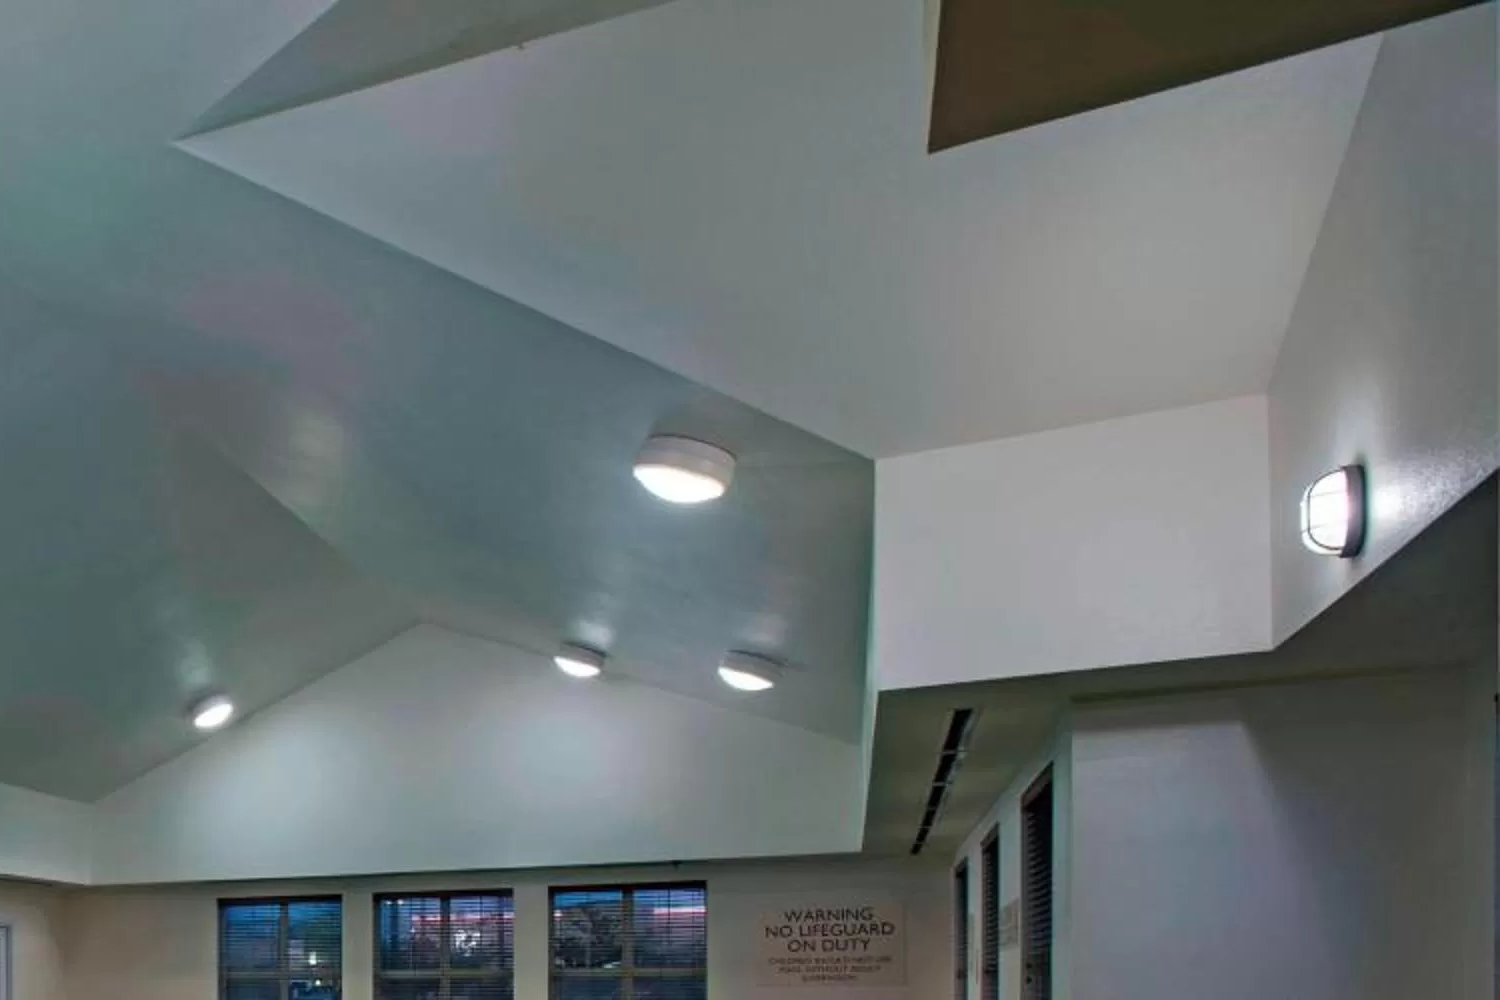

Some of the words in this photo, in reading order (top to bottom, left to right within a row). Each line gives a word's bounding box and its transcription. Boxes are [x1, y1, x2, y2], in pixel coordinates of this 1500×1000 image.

[785, 907, 873, 922] WARNING
[765, 925, 793, 938] NO
[800, 922, 896, 937] LIFEGUARD
[787, 939, 816, 952] ON
[822, 938, 871, 952] DUTY
